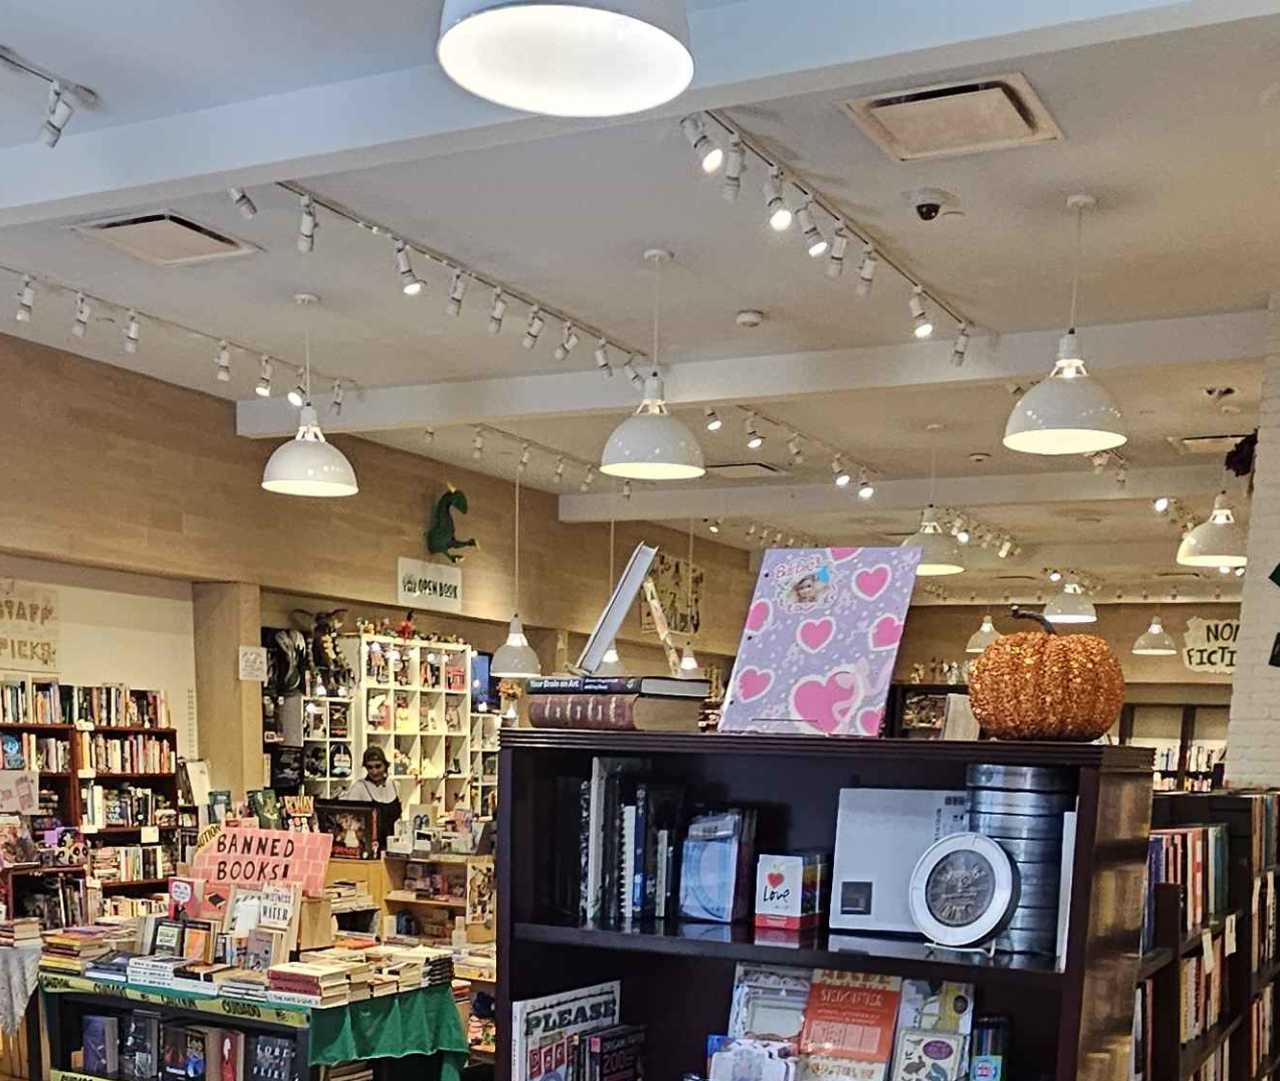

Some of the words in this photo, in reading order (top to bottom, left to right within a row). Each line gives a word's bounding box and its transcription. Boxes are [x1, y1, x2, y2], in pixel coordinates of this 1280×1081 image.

[1187, 647, 1237, 667] FICTI
[529, 680, 543, 688] Your
[568, 680, 580, 688] Art
[217, 834, 295, 858] BANNED
[217, 861, 290, 880] BOOKS!
[763, 885, 790, 902] Love
[222, 1001, 262, 1018] CUIDADO
[525, 998, 617, 1036] PLEASE
